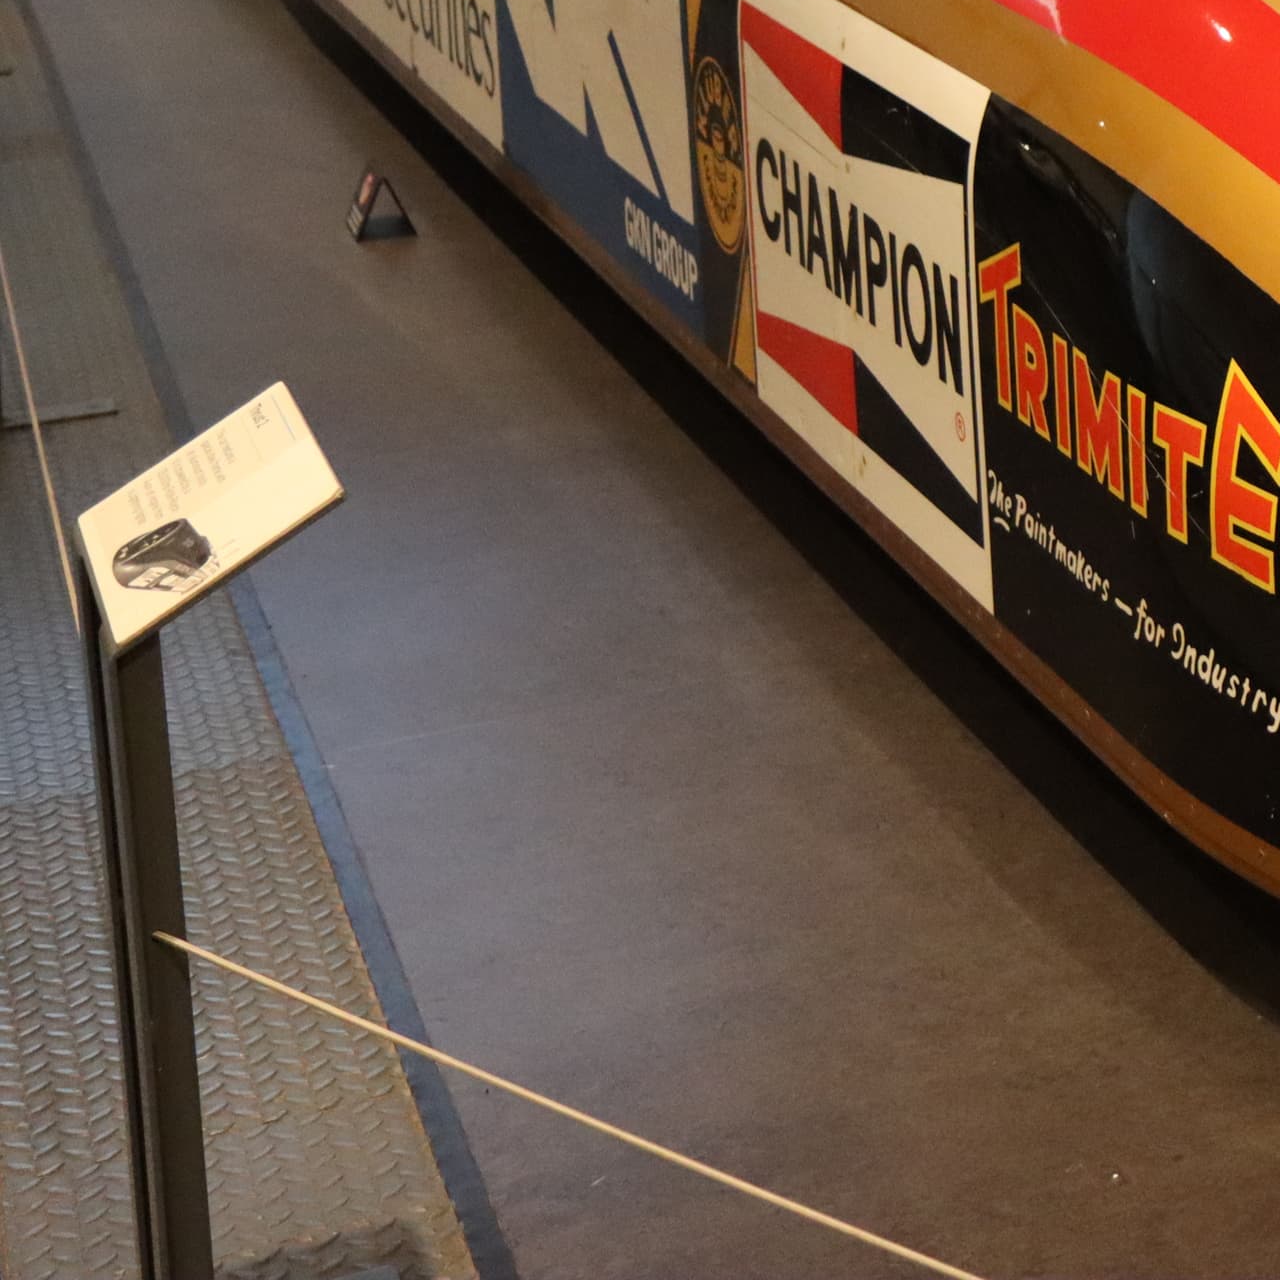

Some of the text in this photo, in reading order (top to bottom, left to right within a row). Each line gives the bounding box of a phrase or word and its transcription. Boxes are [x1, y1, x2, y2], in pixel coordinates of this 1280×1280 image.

[623, 196, 699, 302] GKN GROUP
[756, 137, 965, 398] CHAMPION
[988, 469, 1013, 520] The
[1014, 493, 1111, 602] Paintmakers
[1134, 597, 1166, 649] for
